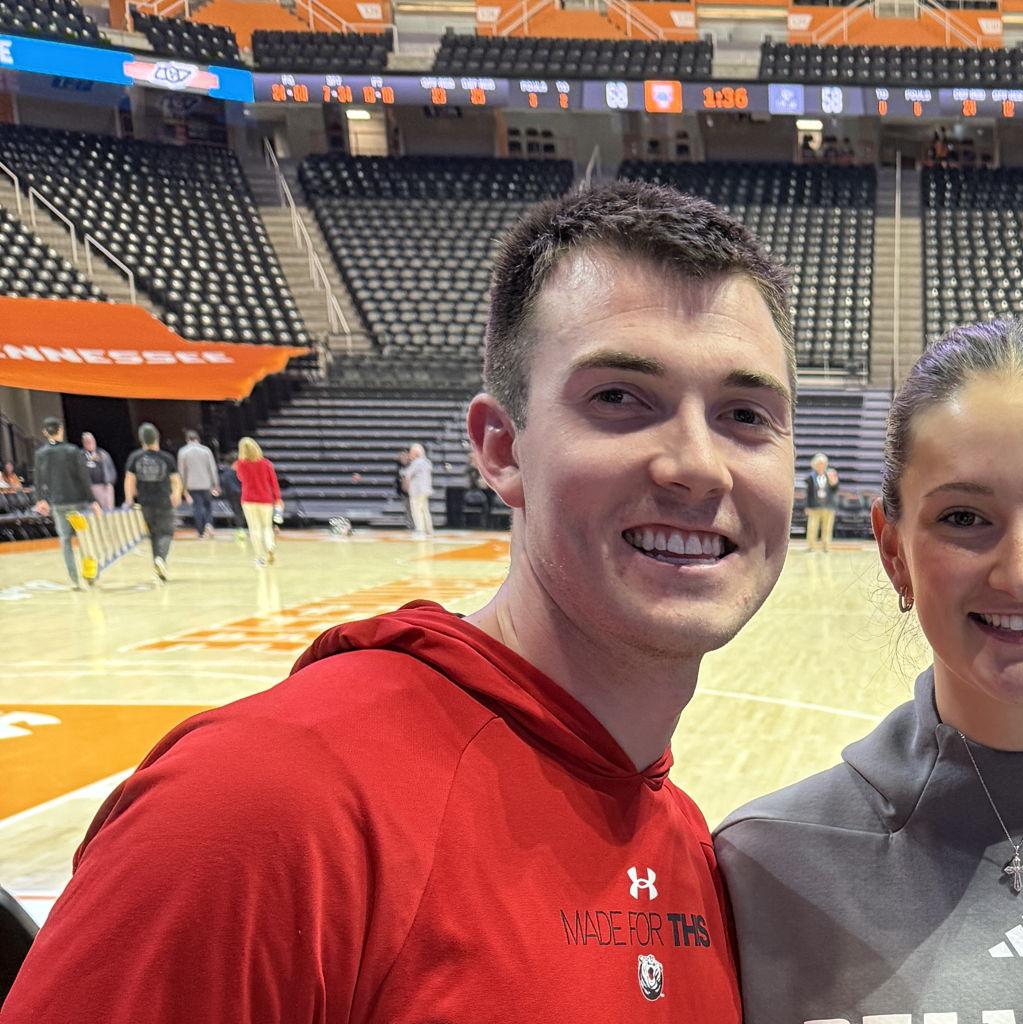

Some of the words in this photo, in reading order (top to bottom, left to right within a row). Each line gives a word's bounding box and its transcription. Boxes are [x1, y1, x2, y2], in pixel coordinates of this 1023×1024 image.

[703, 86, 748, 109] 1:36
[0, 343, 235, 364] NNESSEE
[560, 909, 627, 946] MADE
[629, 911, 664, 946] FOR
